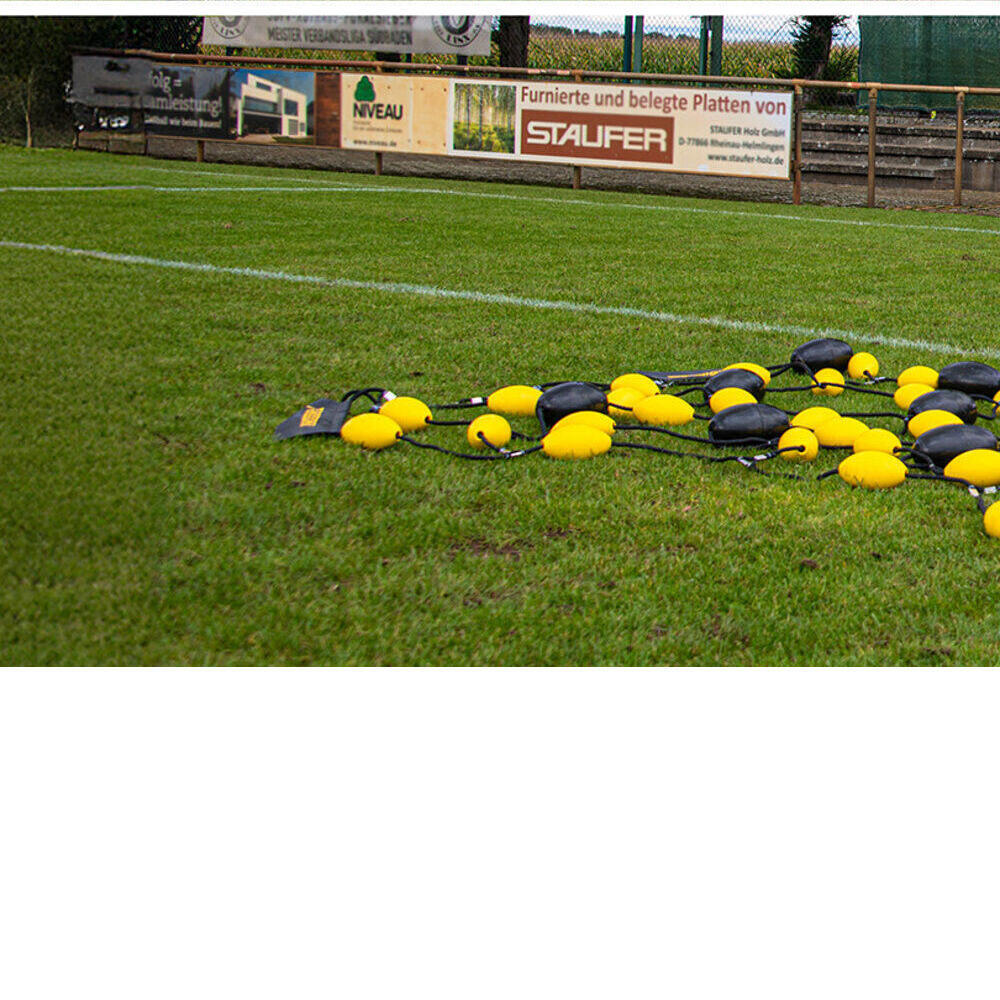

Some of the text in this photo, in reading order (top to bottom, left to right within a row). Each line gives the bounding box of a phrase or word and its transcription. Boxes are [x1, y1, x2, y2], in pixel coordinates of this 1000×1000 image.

[353, 103, 403, 120] NIVEAU
[521, 86, 787, 116] Furnierte und belegte Platten von
[527, 120, 668, 152] STAUFER
[710, 125, 786, 138] STAUFER Holz GmbH
